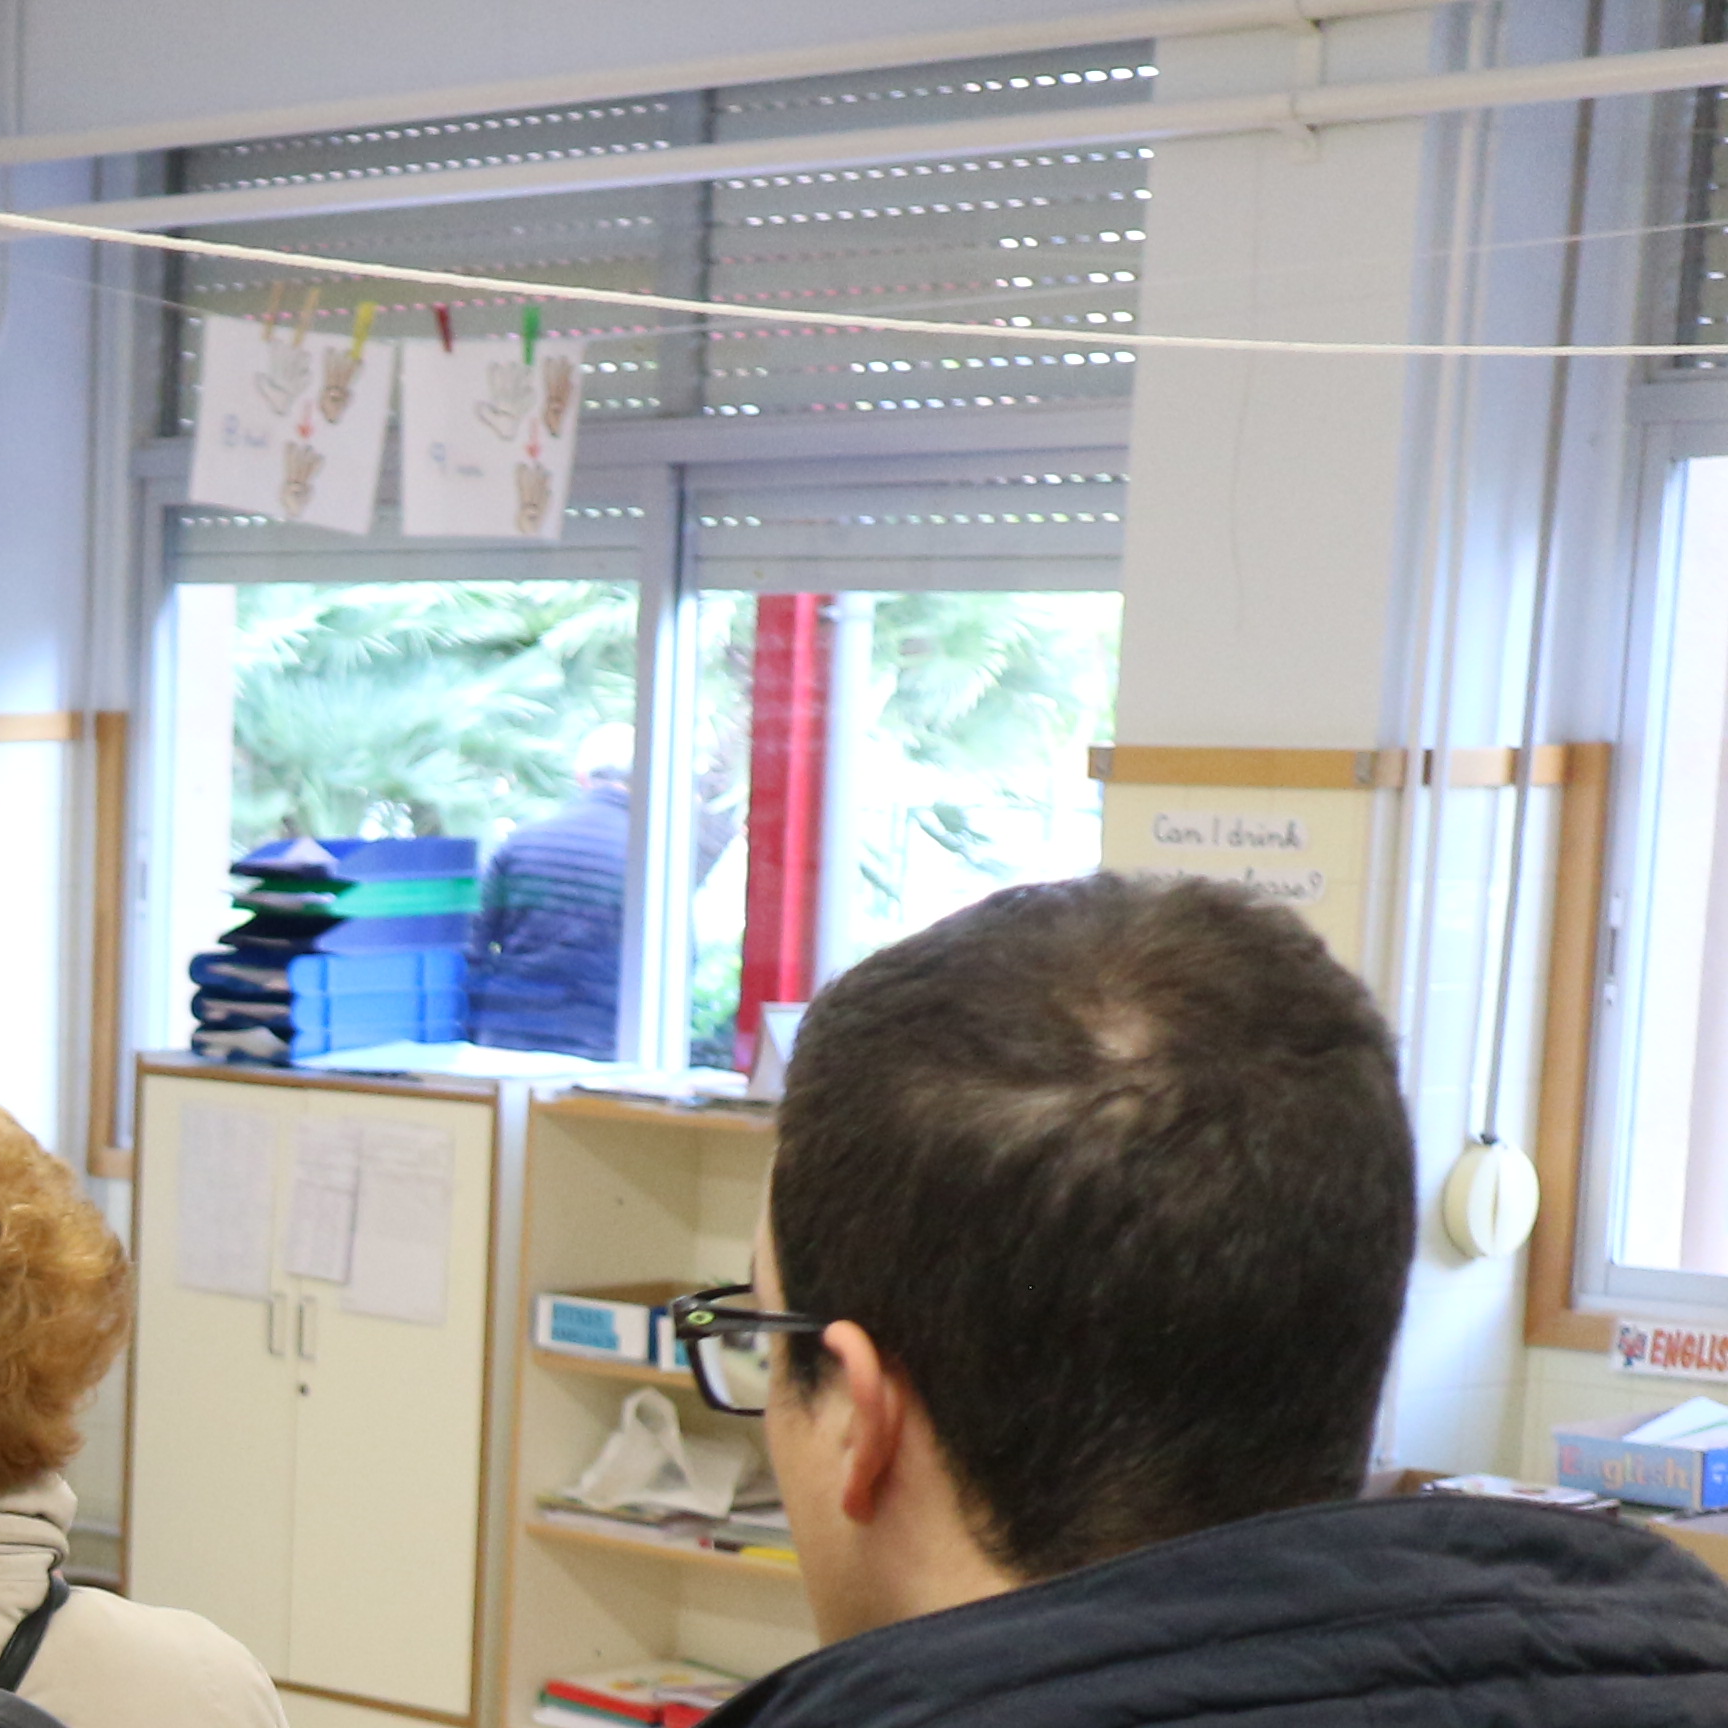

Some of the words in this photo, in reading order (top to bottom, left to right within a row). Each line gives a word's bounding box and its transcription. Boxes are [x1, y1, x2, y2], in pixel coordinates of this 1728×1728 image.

[1152, 811, 1205, 846] Can
[1226, 816, 1302, 851] drink
[1234, 866, 1325, 901] lease?
